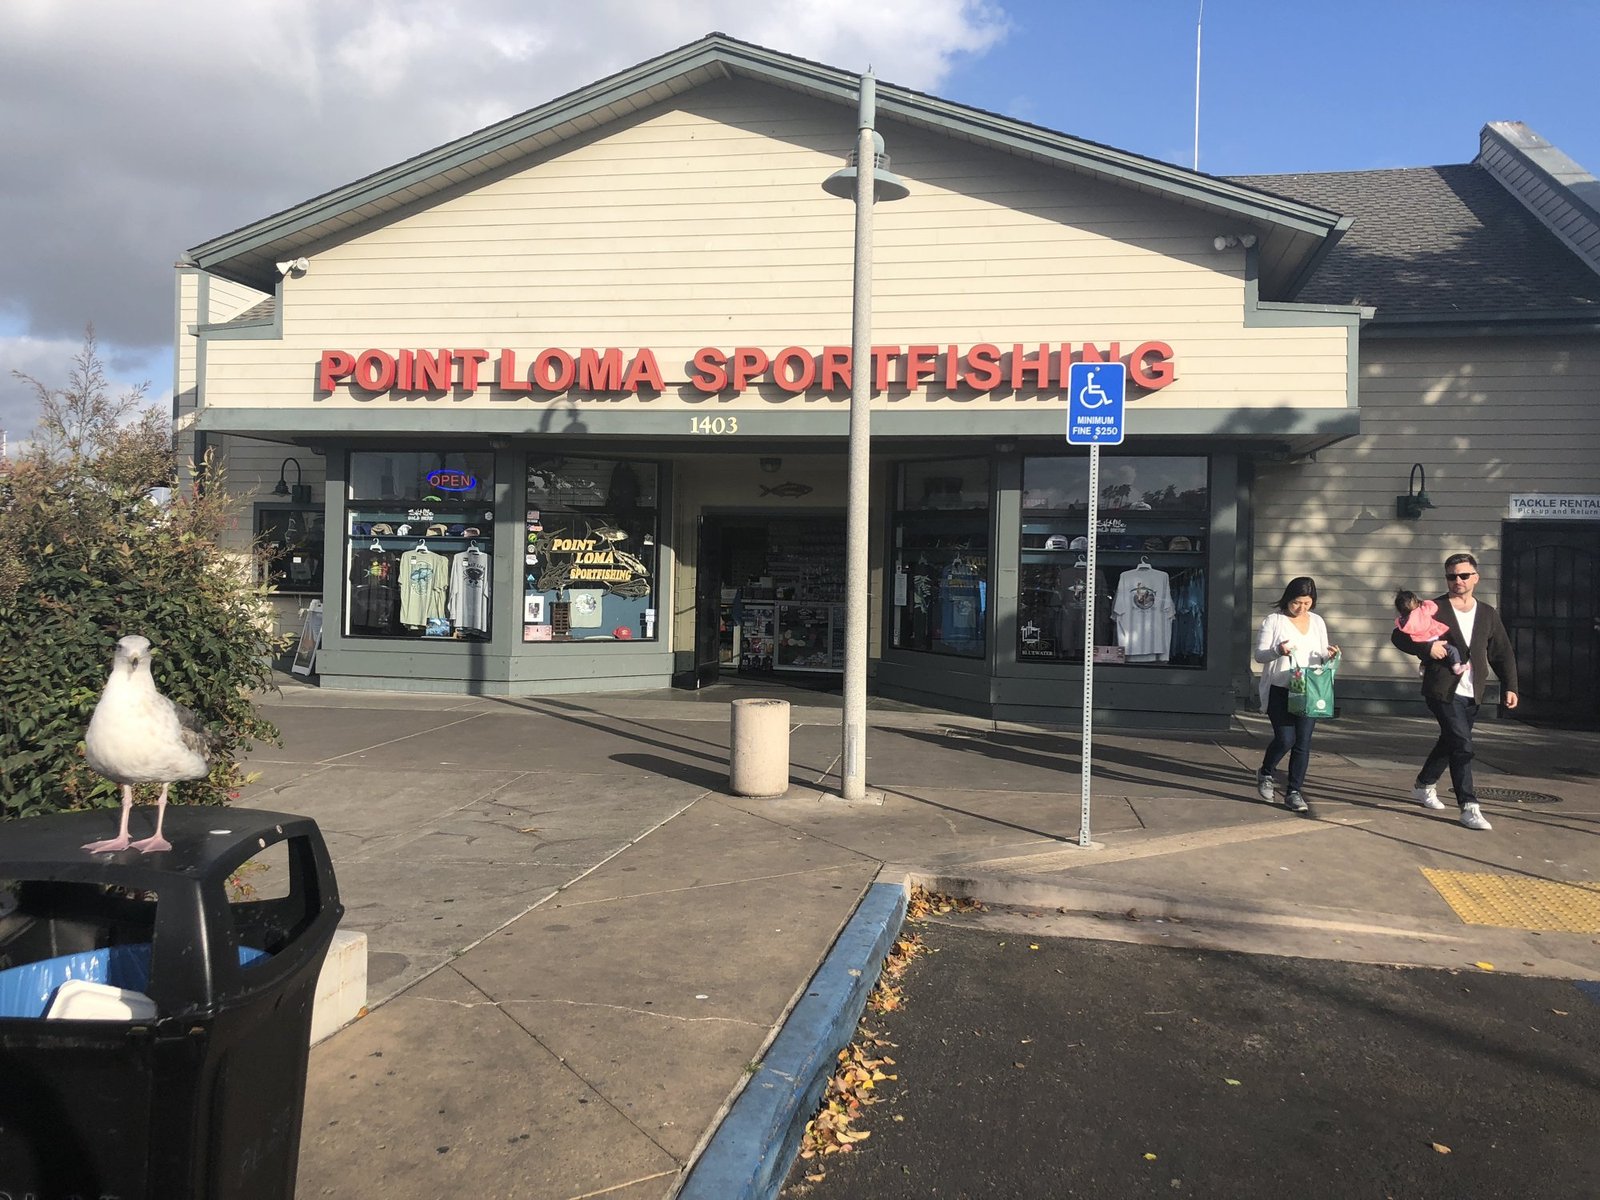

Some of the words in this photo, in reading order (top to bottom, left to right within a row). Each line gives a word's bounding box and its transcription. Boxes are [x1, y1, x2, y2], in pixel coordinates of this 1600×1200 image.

[319, 348, 489, 392] POINT
[500, 347, 666, 392] LOMA
[690, 415, 739, 435] 1403
[1077, 416, 1114, 424] MINIMUM
[1072, 427, 1092, 435] FINE
[1095, 426, 1118, 435] $250
[430, 475, 470, 487] OPEN
[1513, 499, 1557, 508] TACKLE
[551, 539, 597, 551] POINT
[575, 552, 615, 564] LOMA
[570, 568, 632, 581] SPORTFISHING
